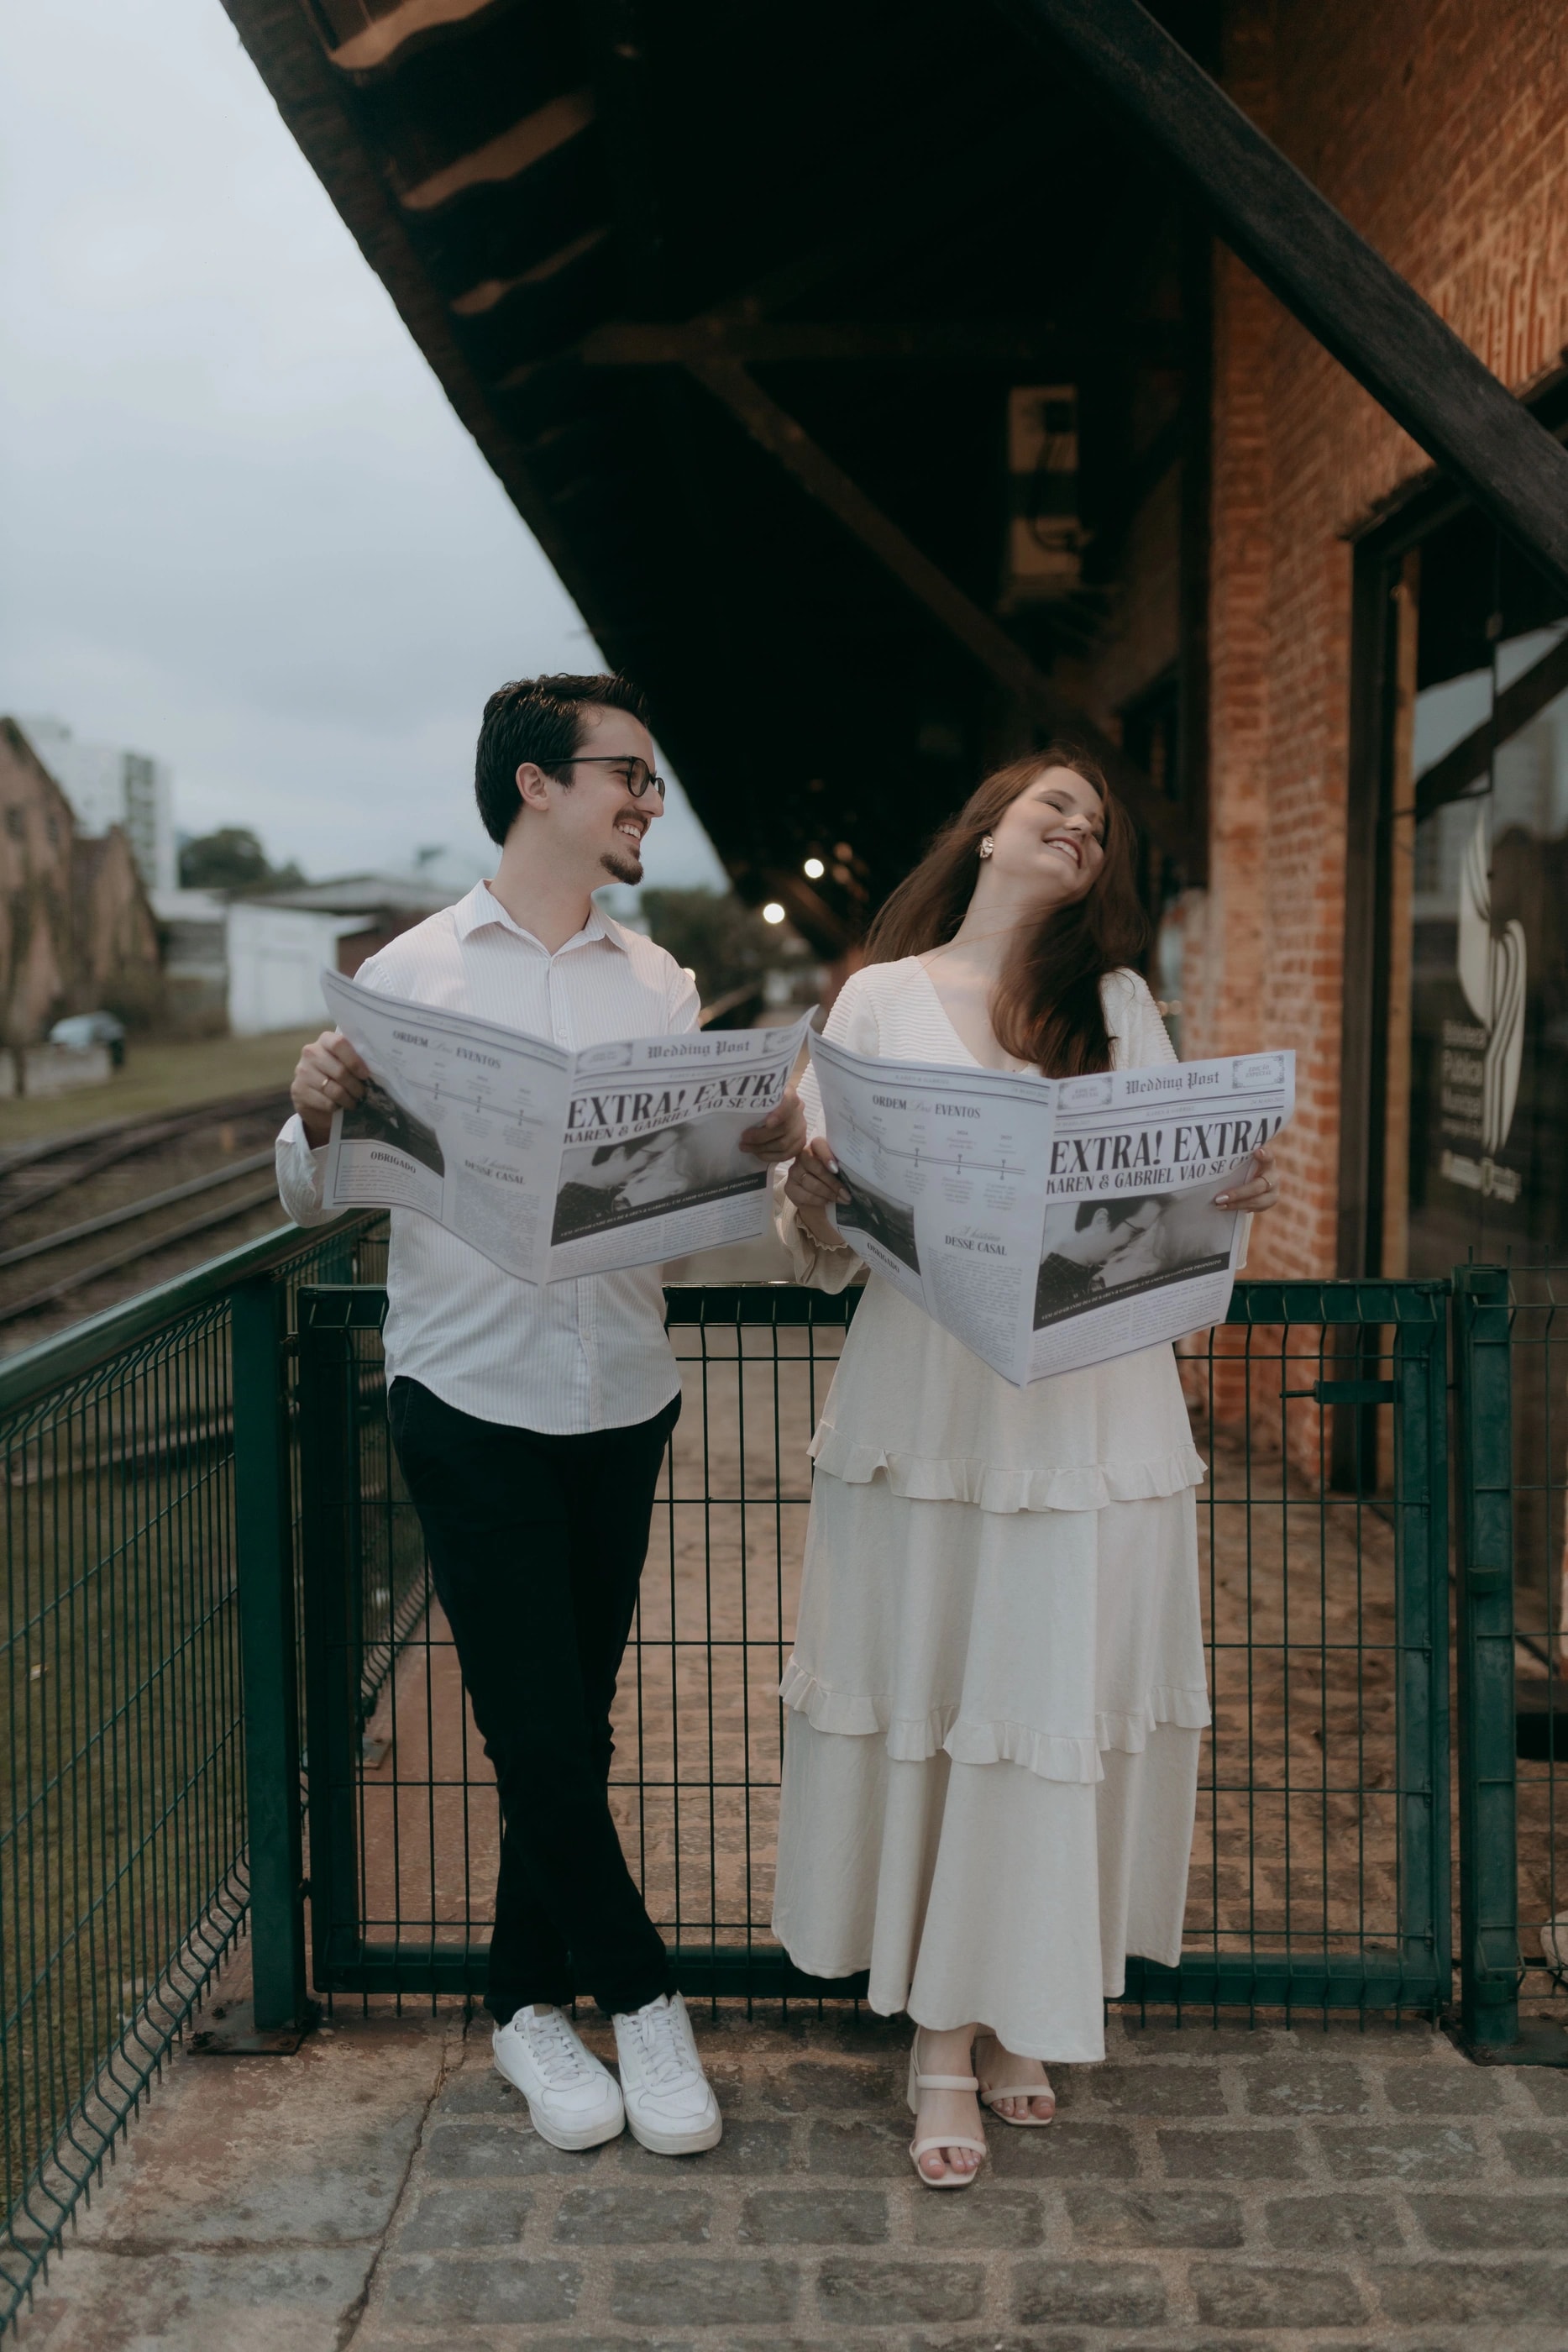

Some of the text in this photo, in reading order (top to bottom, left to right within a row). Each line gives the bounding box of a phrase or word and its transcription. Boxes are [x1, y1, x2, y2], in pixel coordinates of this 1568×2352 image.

[392, 1030, 428, 1048] ORDEM
[456, 1047, 501, 1069] EVENTOS
[648, 1041, 750, 1058] Wedding Post
[1125, 1071, 1219, 1095] Wedding Post
[564, 1127, 614, 1144] KAREN
[618, 1125, 629, 1137] &
[633, 1109, 691, 1132] GABRIEL
[726, 1097, 747, 1109] SE
[567, 1089, 686, 1130] EXTRA!
[872, 1095, 907, 1110] ORDEM
[935, 1103, 981, 1119] EVENTOS
[370, 1151, 417, 1173] OBRIGADO
[1049, 1129, 1163, 1175] EXTRA!
[464, 1159, 526, 1185] DESSE CASAL
[1046, 1175, 1094, 1194] KAREN
[1099, 1173, 1109, 1190] &
[1114, 1168, 1174, 1189] GABRIEL
[1209, 1159, 1227, 1176] SE
[867, 1242, 900, 1273] OBRIGADO
[945, 1235, 1008, 1256] DESSE CASAL
